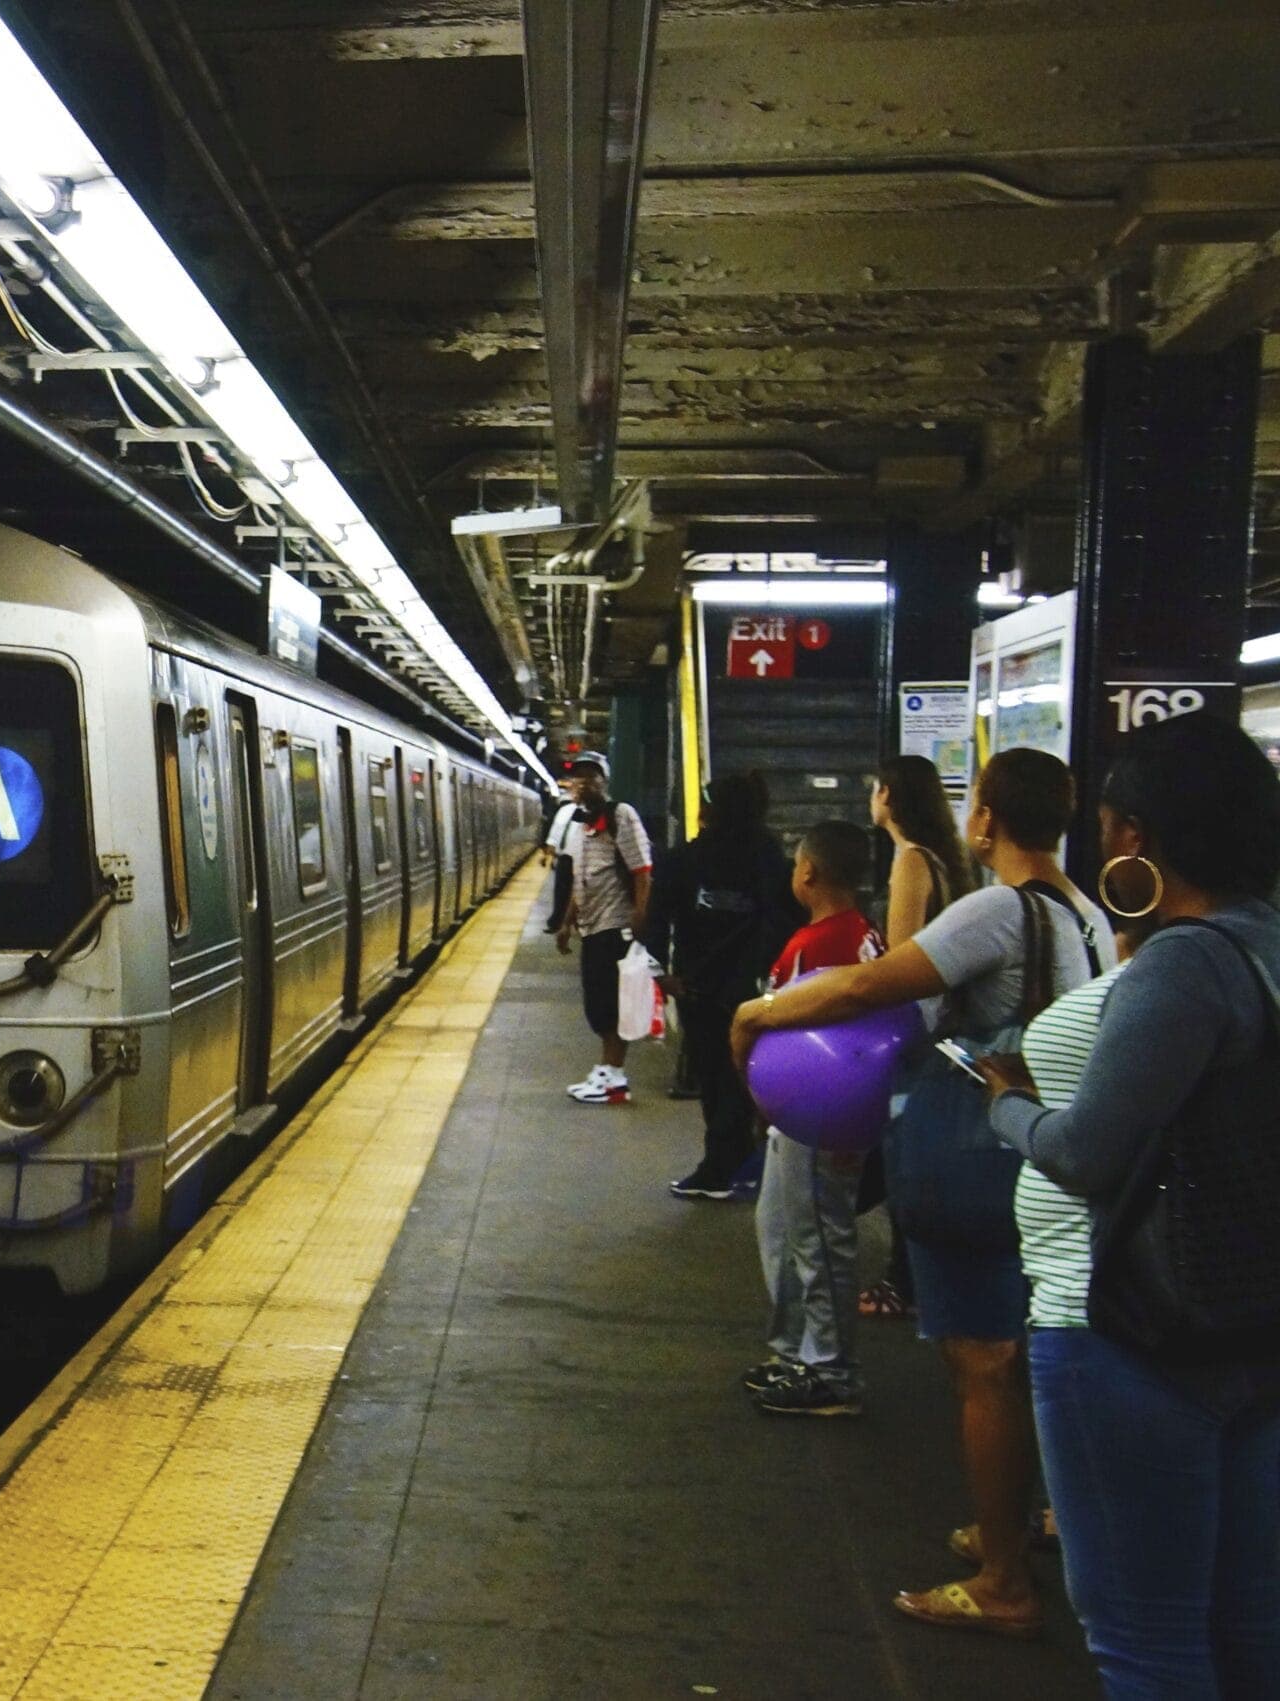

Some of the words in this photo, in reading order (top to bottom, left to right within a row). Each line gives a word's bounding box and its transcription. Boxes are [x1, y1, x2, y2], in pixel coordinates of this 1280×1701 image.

[731, 616, 787, 641] Exit
[808, 625, 819, 643] 1
[1107, 688, 1205, 732] 168
